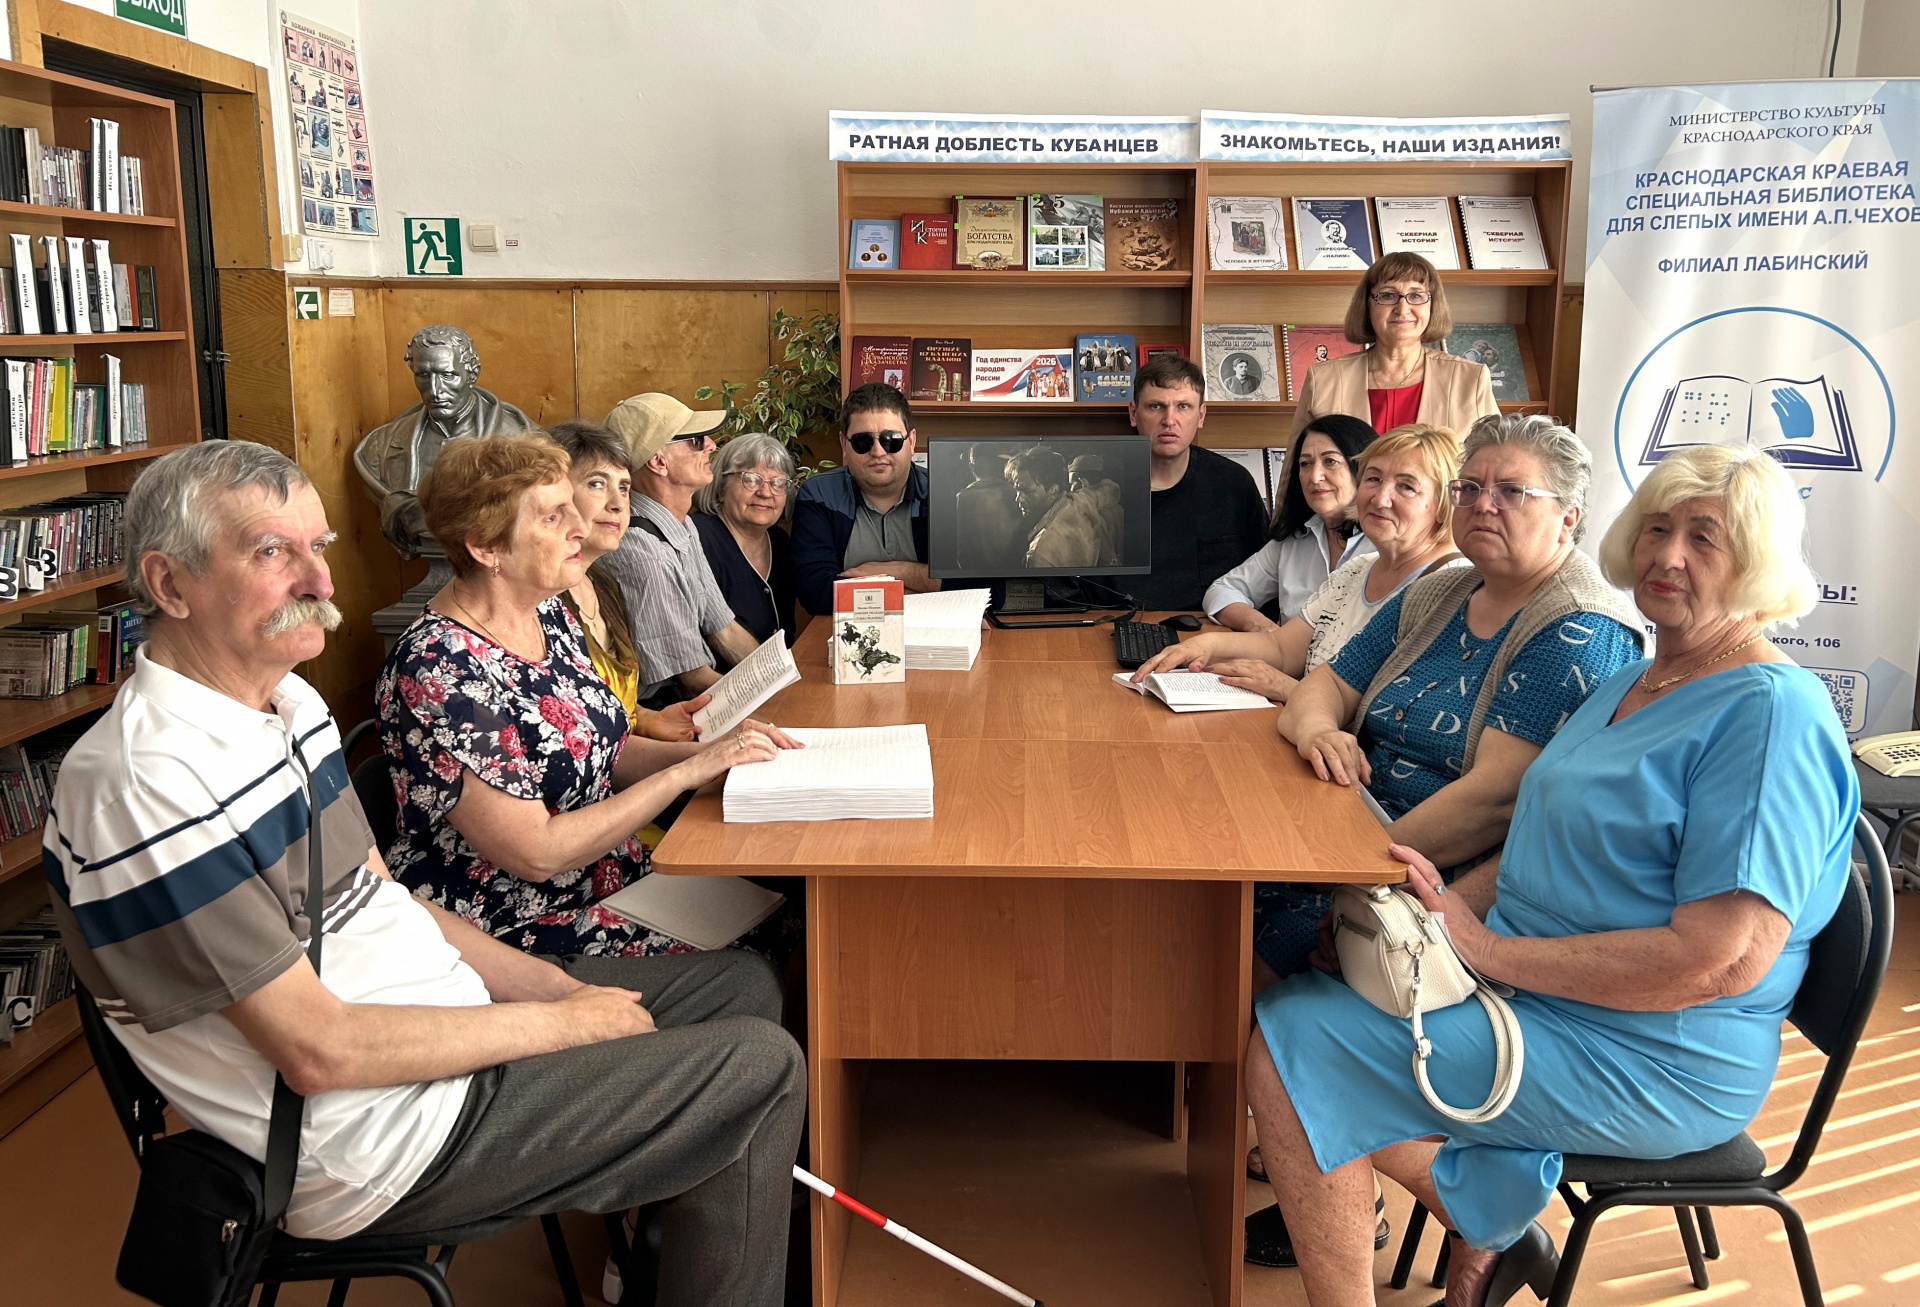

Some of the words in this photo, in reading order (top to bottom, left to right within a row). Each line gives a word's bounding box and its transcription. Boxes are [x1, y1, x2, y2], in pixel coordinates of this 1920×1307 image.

[118, 0, 183, 25] ХОД
[1668, 107, 1801, 127] МИНИСТЕРСТВО
[1804, 103, 1887, 120] КУЛЬТУРЫ
[849, 134, 930, 150] РАТНАЯ
[935, 136, 1045, 153] ДОБЛЕСТЬ
[1050, 138, 1159, 154] КУБАНЦЕВ
[1220, 134, 1376, 155] ЗНАКОМЬТЕСЬ,
[1382, 138, 1446, 154] НАШИ
[1453, 136, 1561, 154] ИЗДАНИЯ!
[1683, 125, 1829, 144] КРАСНОДАРСКОГО
[1832, 123, 1873, 137] КРАЯ
[1635, 164, 1807, 189] КРАСНОДАРСКАЯ
[1812, 160, 1909, 180] КРАЕВАЯ
[1625, 189, 1772, 211] СПЕЦИАЛЬНАЯ
[1777, 183, 1916, 204] БИБЛИОТЕКА
[1606, 216, 1645, 236] ДЛЯ
[1649, 212, 1732, 231] СЛЕПЫХ
[1737, 208, 1808, 228] ИМЕНИ
[1658, 257, 1738, 274] ФИЛИАЛ
[1743, 250, 1869, 272] ЛАБИНСКИЙ
[1814, 637, 1841, 648] 106
